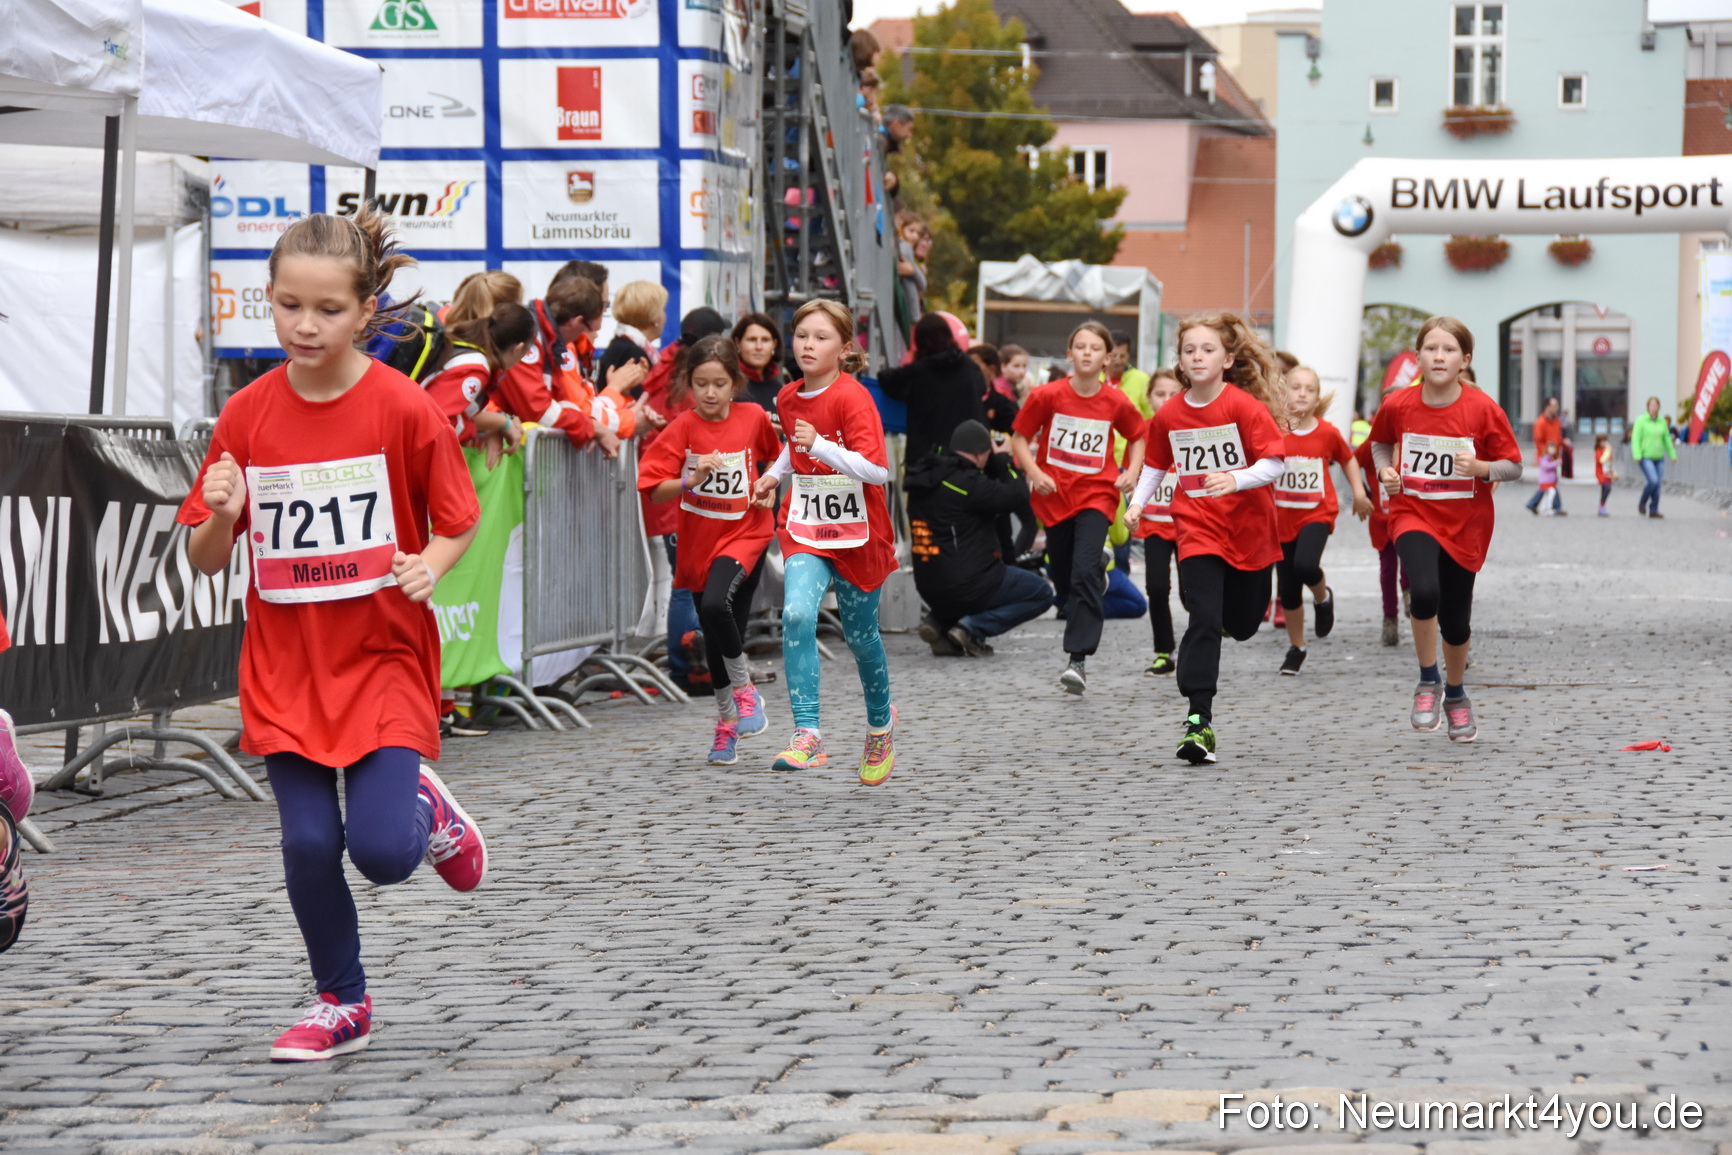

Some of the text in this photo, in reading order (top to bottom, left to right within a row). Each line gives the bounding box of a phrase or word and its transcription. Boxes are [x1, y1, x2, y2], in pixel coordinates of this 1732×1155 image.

[557, 106, 599, 128] Braun
[336, 192, 428, 217] swn
[1391, 175, 1723, 218] BMW Laufsport
[545, 210, 618, 222] Neumarkter
[532, 223, 631, 239] Lammsbräu
[1694, 357, 1726, 422] REWE
[1057, 428, 1104, 453] 7182
[1179, 441, 1239, 471] 7218
[1409, 450, 1454, 477] 720
[301, 462, 375, 485] BOCK
[800, 493, 860, 520] 7164
[258, 491, 378, 550] 7217
[816, 527, 838, 538] Mira
[385, 533, 392, 541] K
[292, 561, 359, 583] Melina
